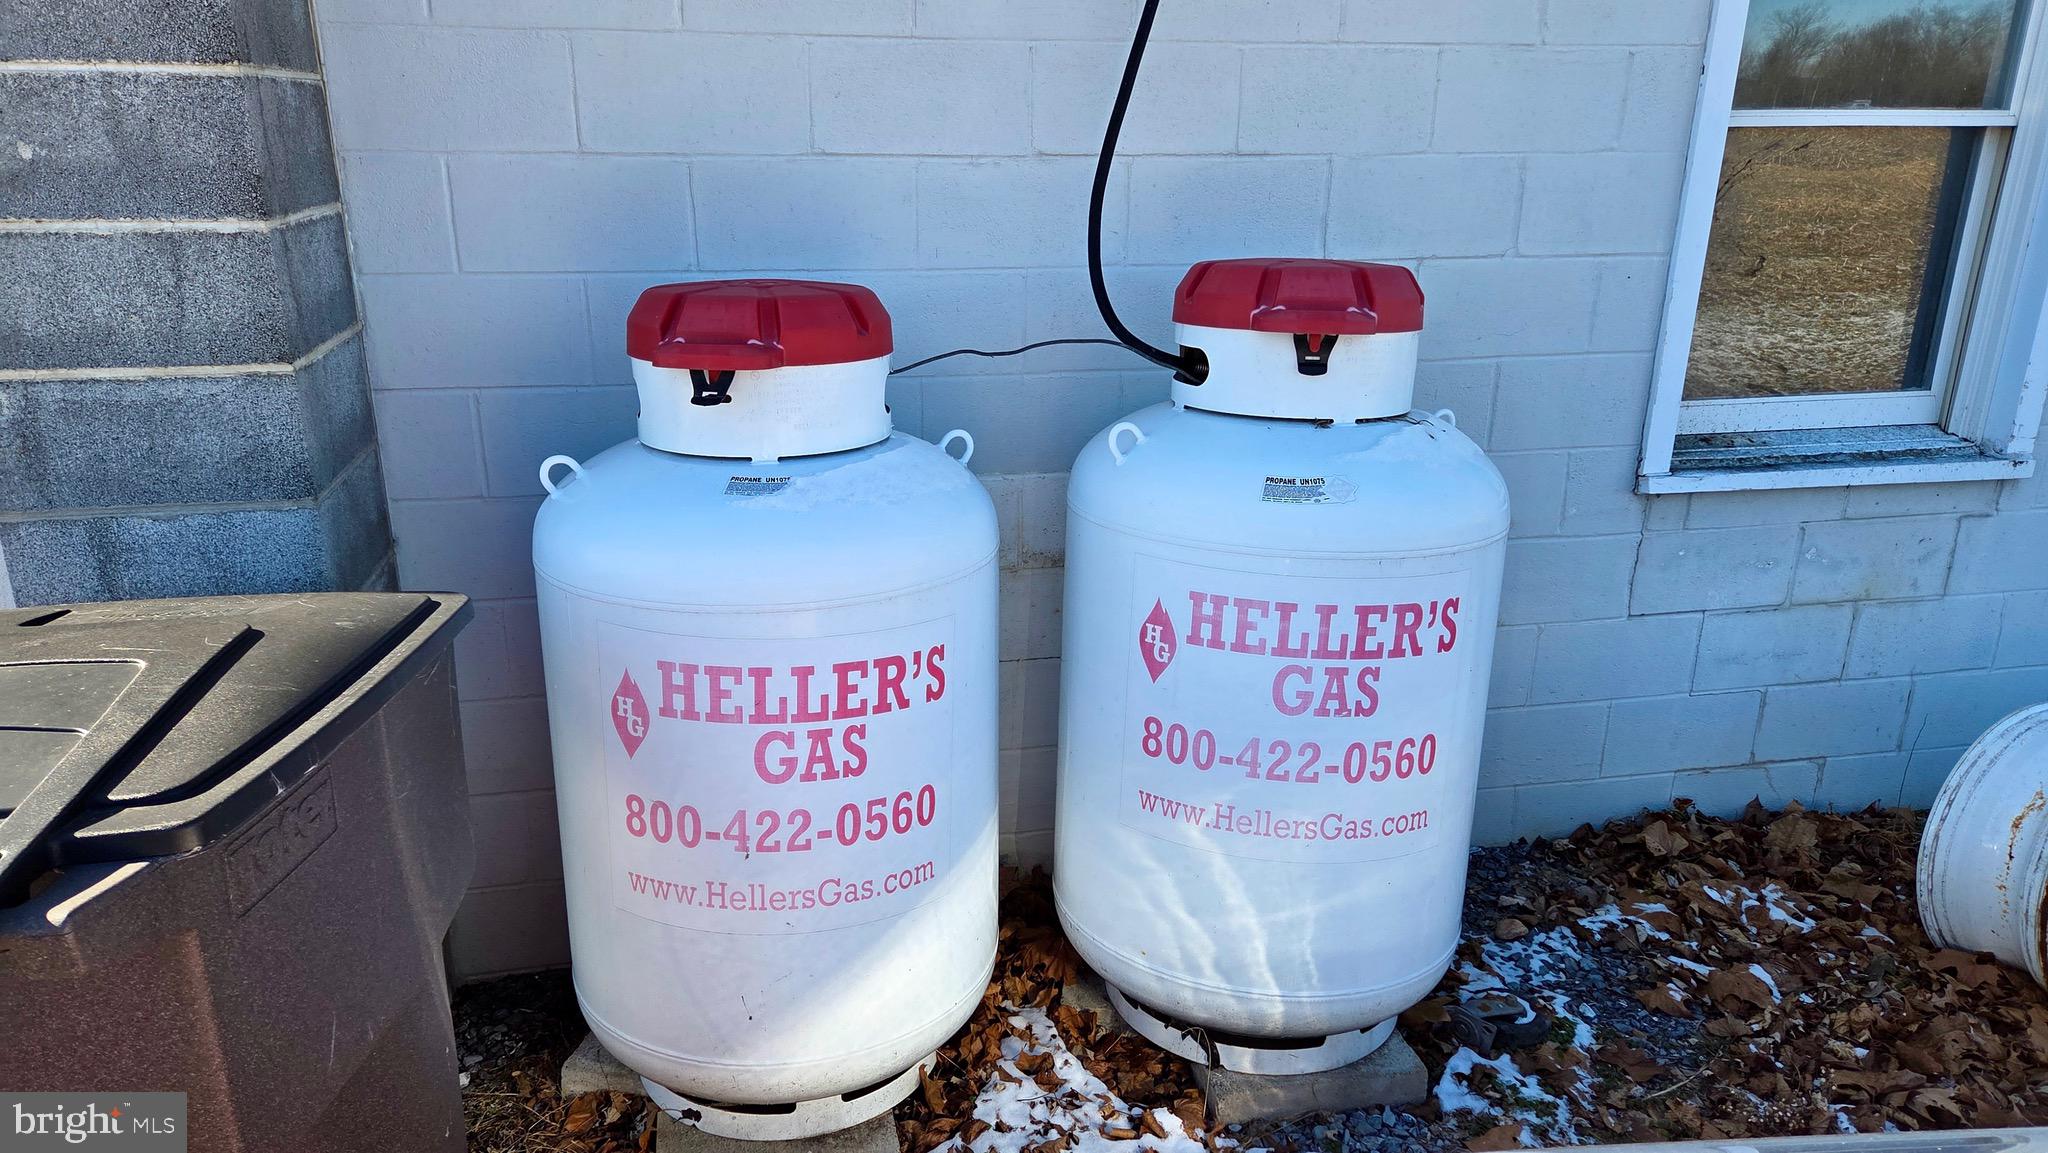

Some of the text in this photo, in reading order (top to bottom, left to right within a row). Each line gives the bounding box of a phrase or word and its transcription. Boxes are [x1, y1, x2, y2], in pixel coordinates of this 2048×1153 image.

[1265, 477, 1325, 485] PROPANE UN1075
[1186, 590, 1460, 661] HELLER'S
[656, 643, 946, 725] HELLER'S
[1272, 665, 1380, 718] GAS
[753, 723, 868, 785] GAS
[1141, 716, 1437, 784] 800-422-0560
[624, 784, 937, 853] 800-422-0560
[1138, 788, 1429, 841] www.HellersGas.com
[628, 860, 935, 912] www.HellersGas.com
